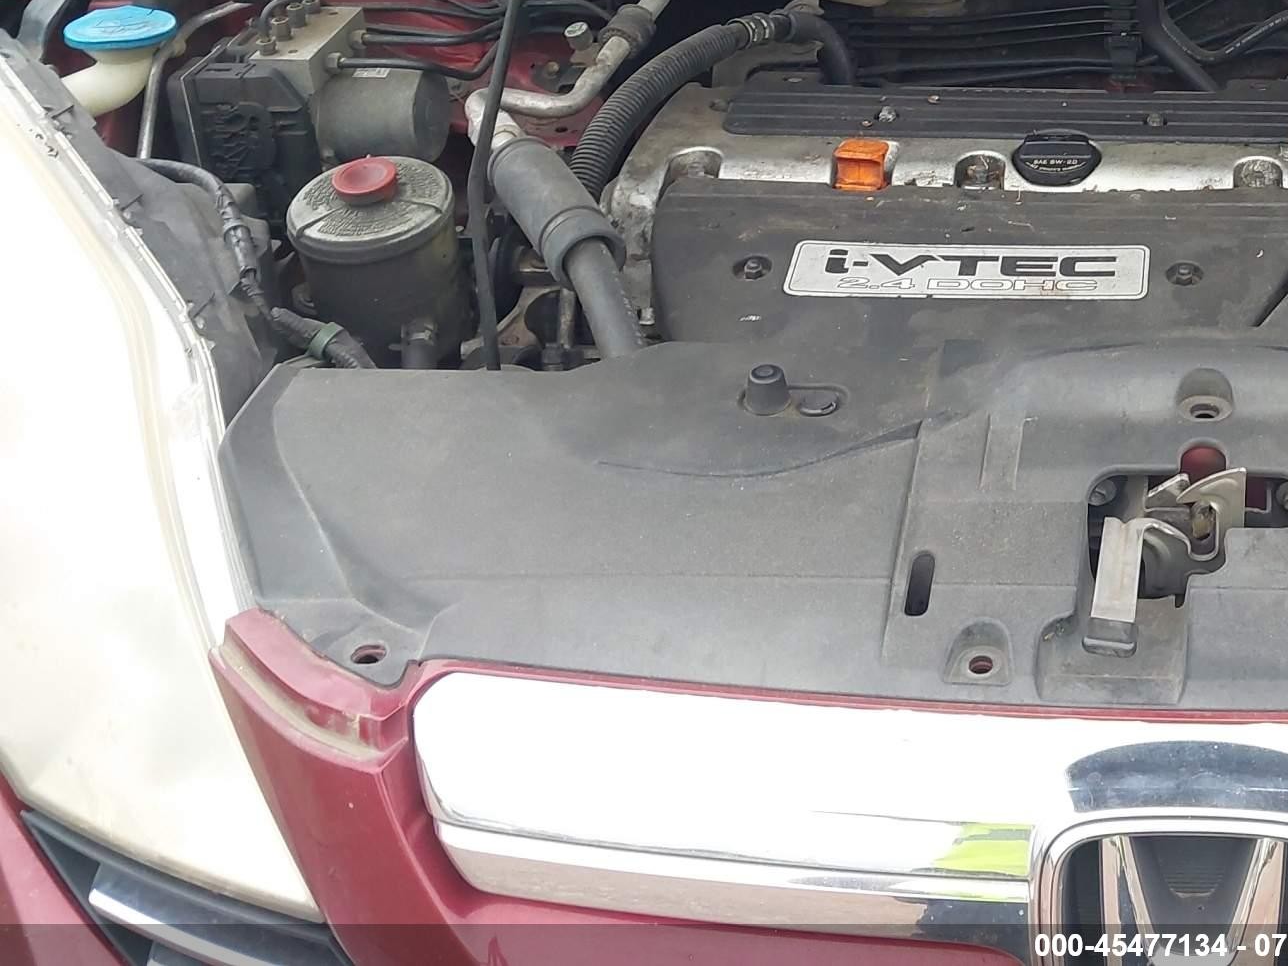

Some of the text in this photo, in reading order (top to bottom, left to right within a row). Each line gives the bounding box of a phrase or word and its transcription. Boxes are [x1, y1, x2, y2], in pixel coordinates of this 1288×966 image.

[824, 249, 1118, 277] i-VTEC
[837, 276, 1099, 292] 2.4 DOHC
